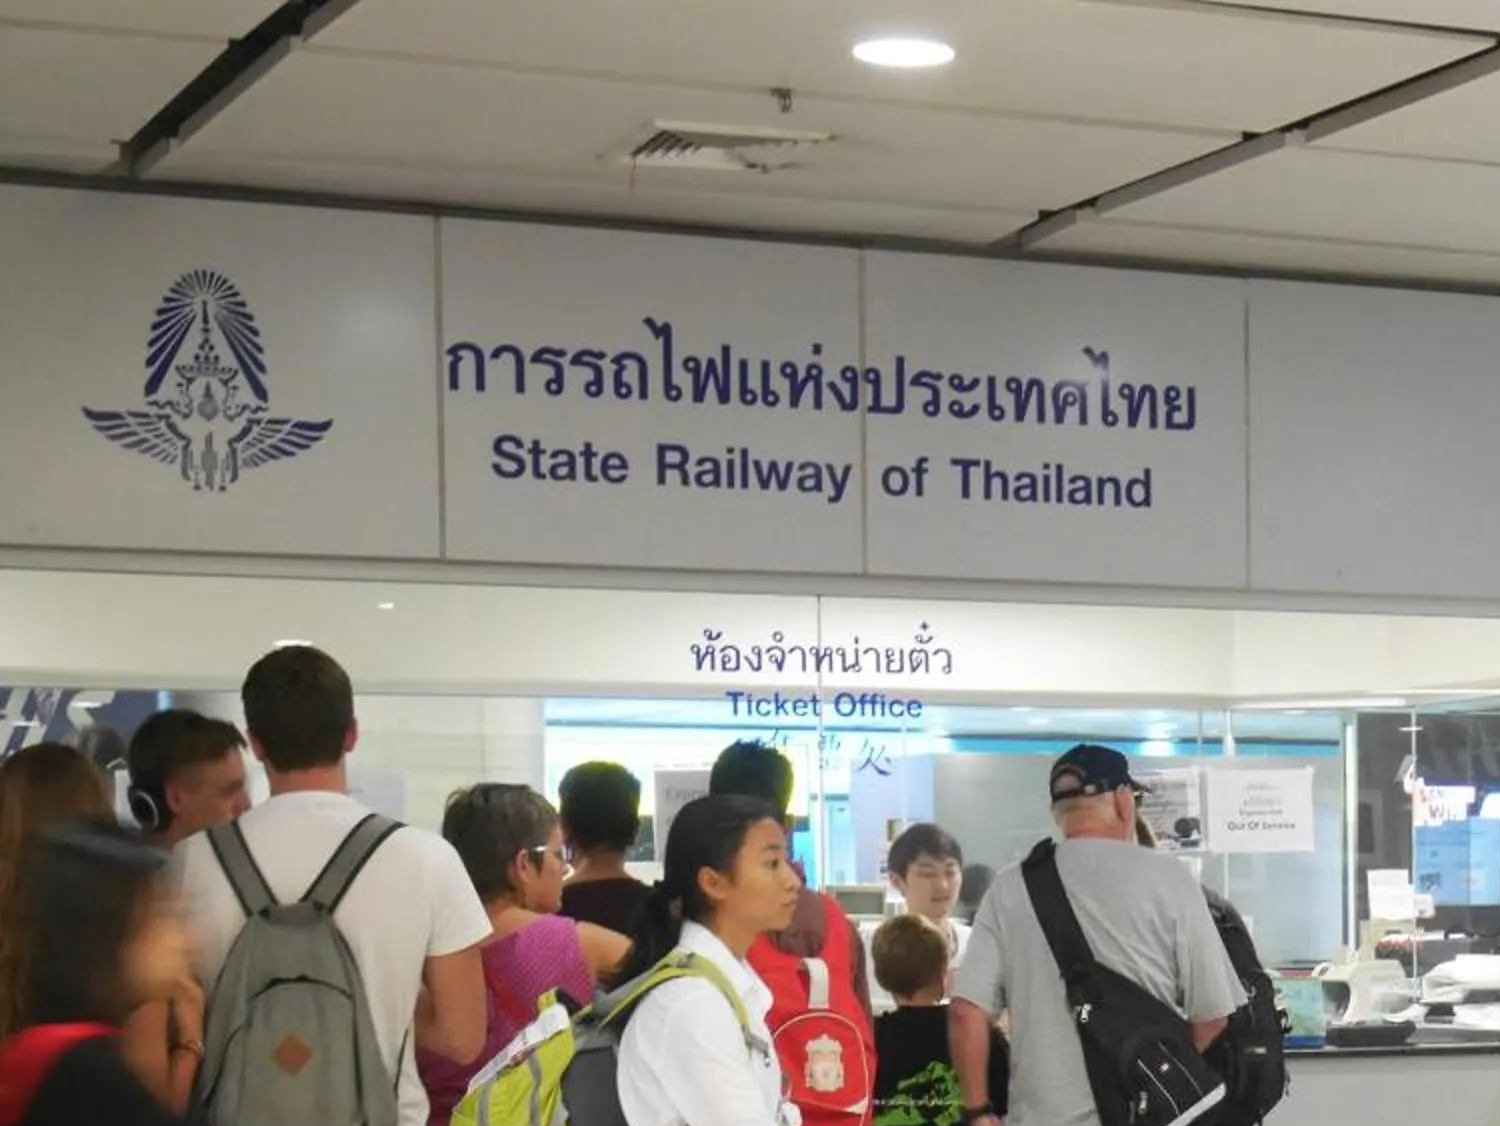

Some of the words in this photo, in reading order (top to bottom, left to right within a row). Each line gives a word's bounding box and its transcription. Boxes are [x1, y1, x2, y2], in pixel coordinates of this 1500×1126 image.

[446, 317, 1197, 431] การรถไฟแห่งประเทศไทย
[492, 434, 629, 484] State
[656, 443, 852, 504] Railway
[881, 457, 929, 497] of
[950, 458, 1152, 508] Thailand
[690, 621, 953, 674] ห้องจำหน่ายตั๋ว
[725, 691, 821, 717] Ticket
[834, 692, 923, 718] Office
